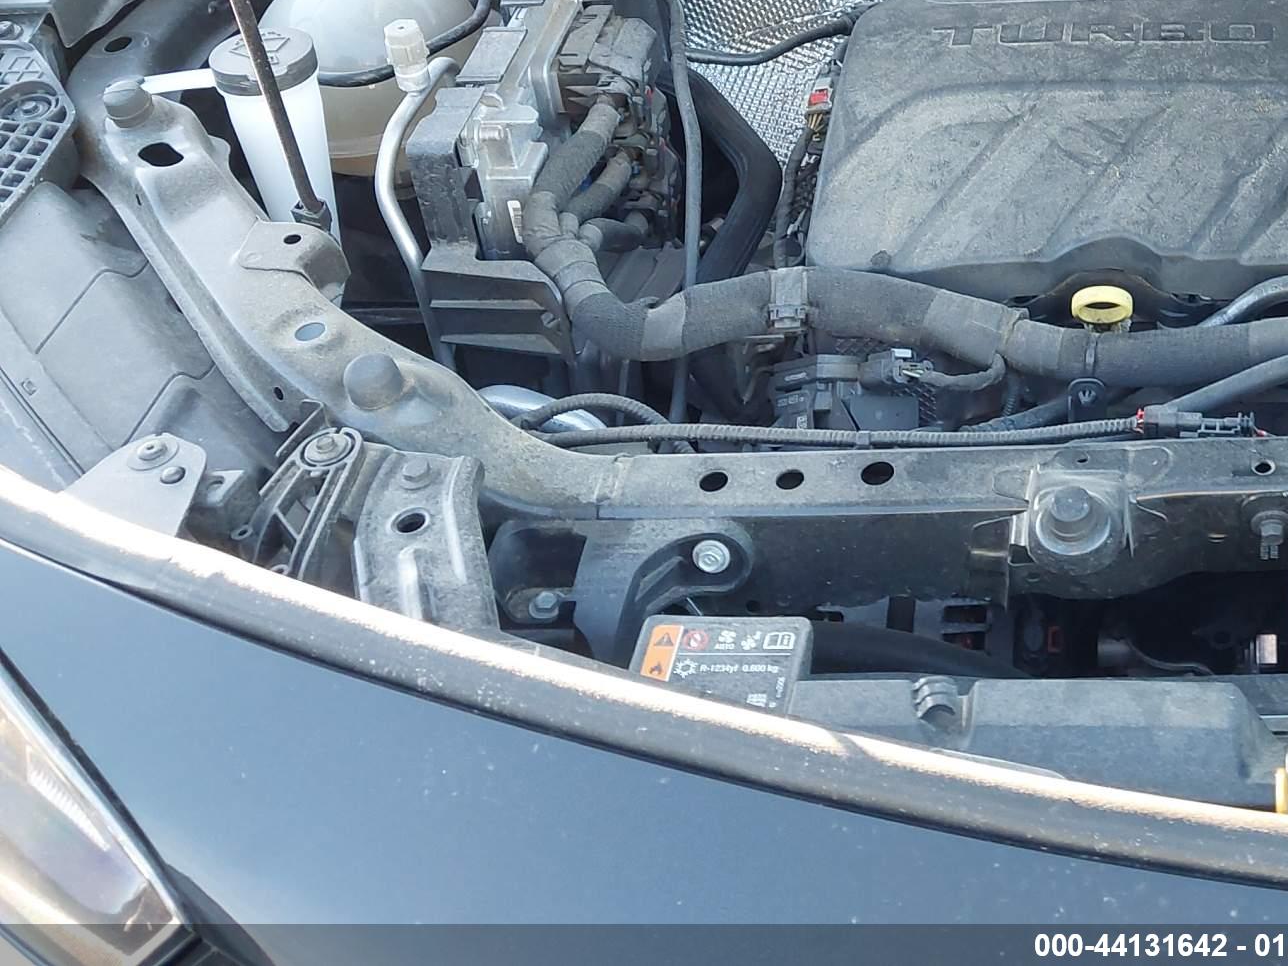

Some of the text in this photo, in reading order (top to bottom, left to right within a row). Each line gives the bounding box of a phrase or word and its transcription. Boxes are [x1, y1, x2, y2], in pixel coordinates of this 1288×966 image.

[932, 22, 1274, 47] TURBO
[700, 664, 738, 674] R-1234yf
[767, 664, 779, 674] kg
